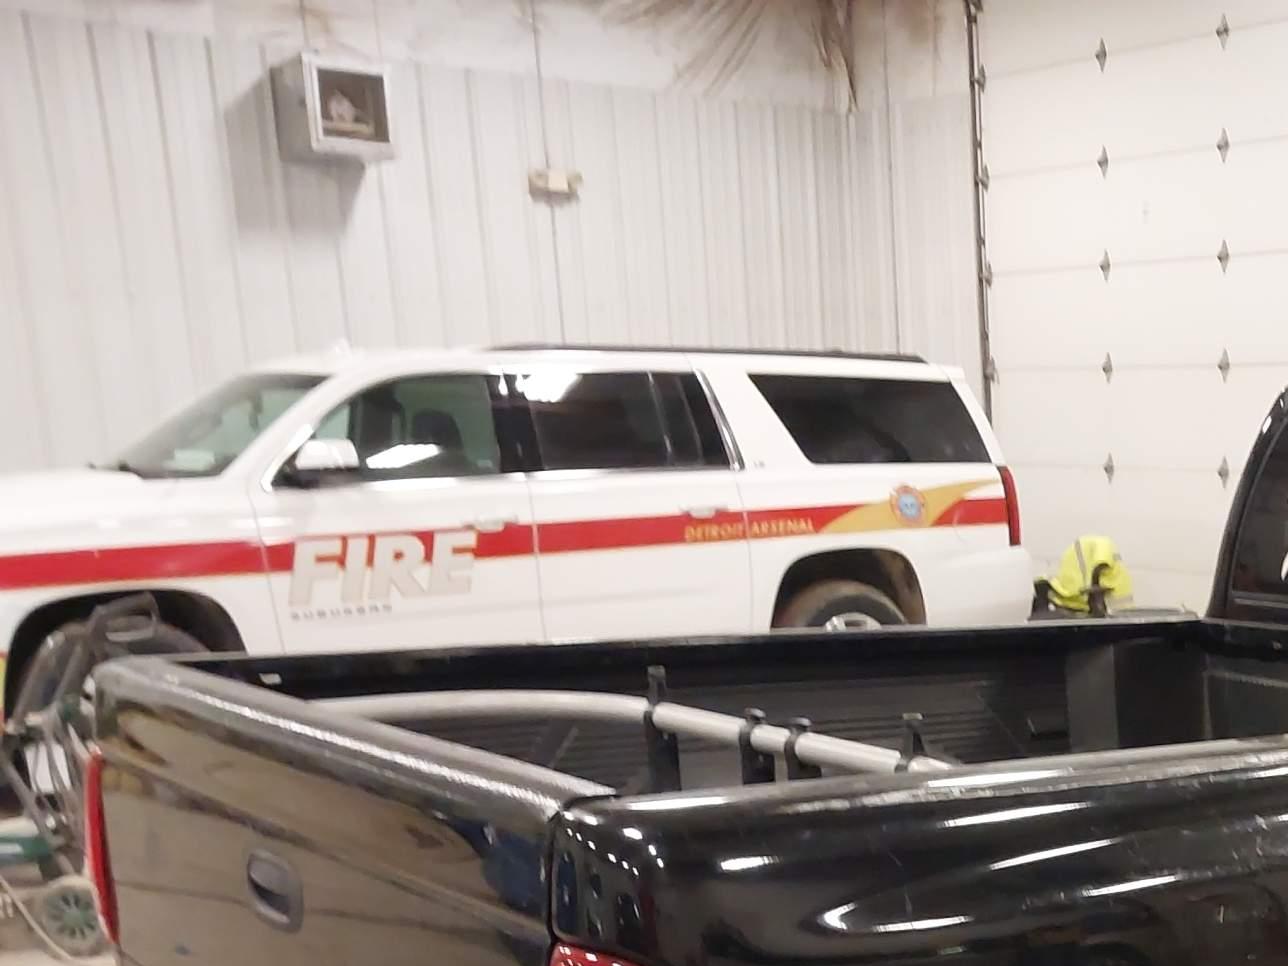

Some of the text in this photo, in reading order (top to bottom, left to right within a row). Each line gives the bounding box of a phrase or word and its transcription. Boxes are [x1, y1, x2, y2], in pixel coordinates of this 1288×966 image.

[685, 518, 815, 542] DETROIT ARSENAL
[288, 530, 476, 607] FIRE
